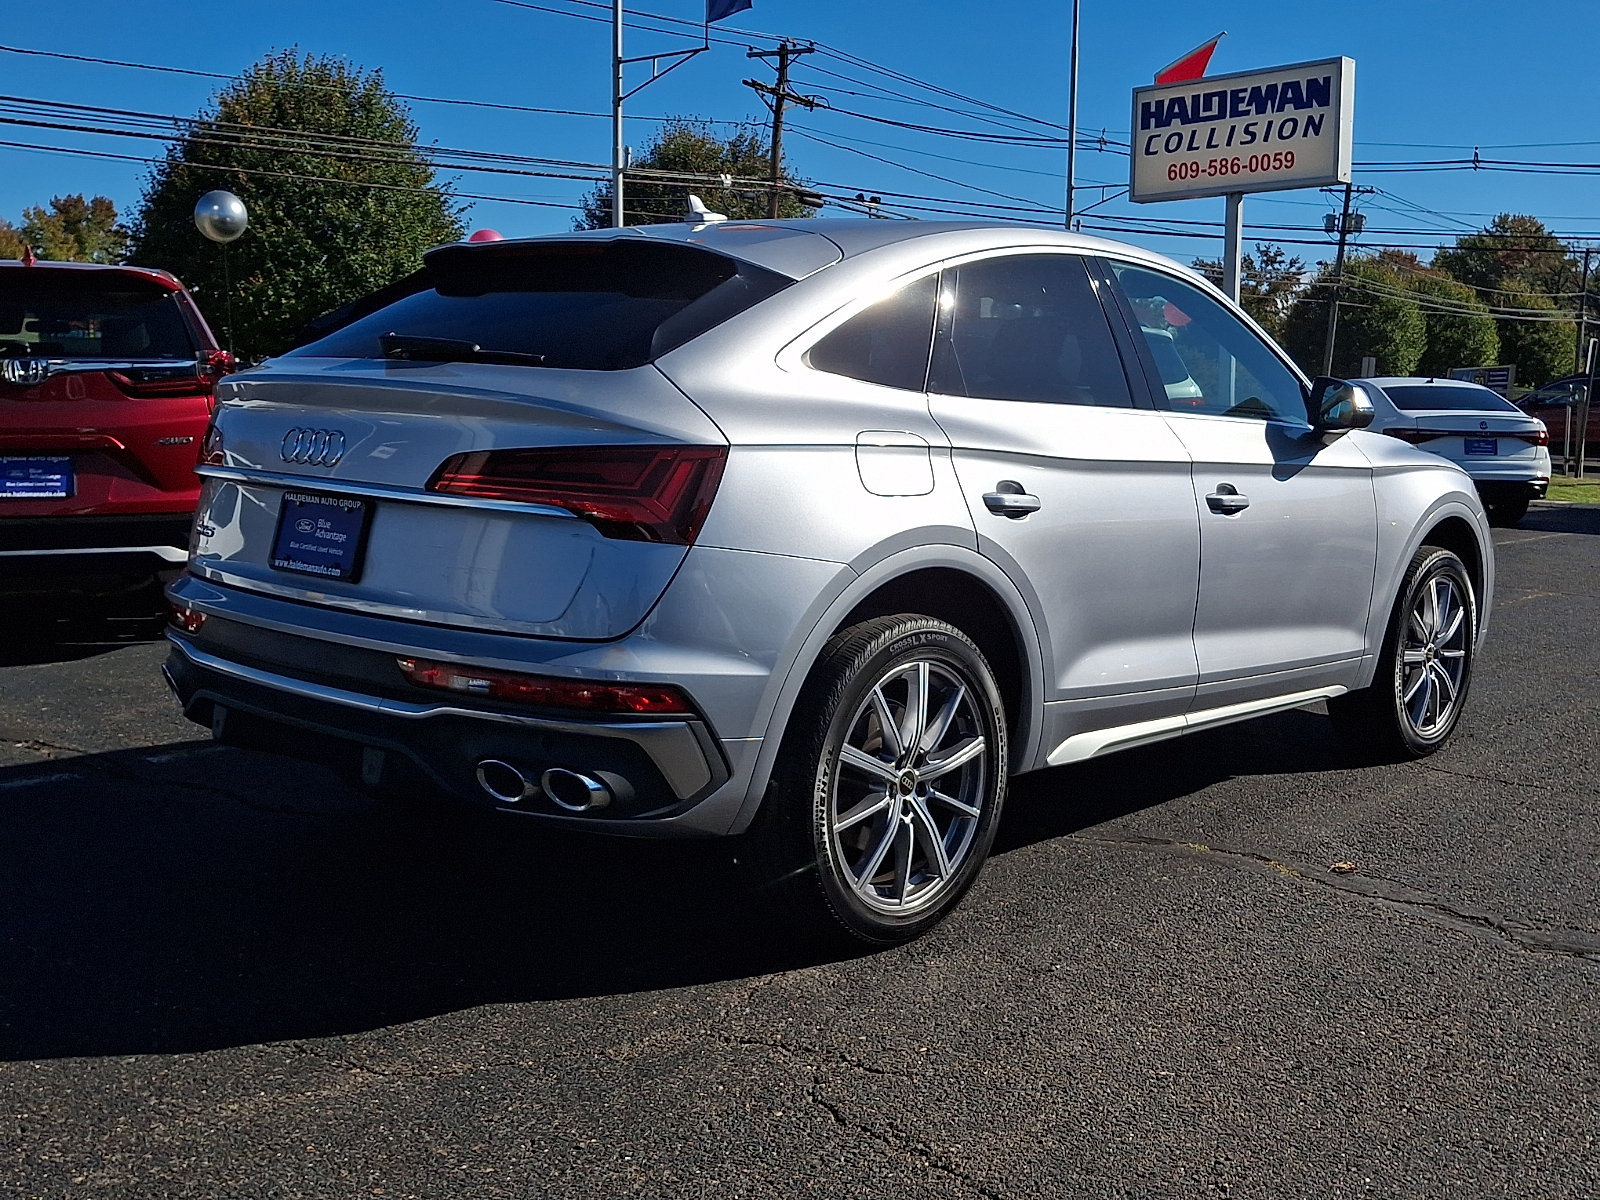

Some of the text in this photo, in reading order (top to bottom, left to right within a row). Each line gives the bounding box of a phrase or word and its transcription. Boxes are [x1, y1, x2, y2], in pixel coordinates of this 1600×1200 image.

[1140, 75, 1332, 131] HALDEMAN
[1144, 113, 1325, 156] COLLISION
[1167, 150, 1295, 181] 609-586-0059
[284, 492, 362, 509] HALDEMAN AUTO GROUP
[317, 518, 331, 529] Blue
[314, 528, 347, 543] Advantage
[927, 633, 948, 642] SPORT
